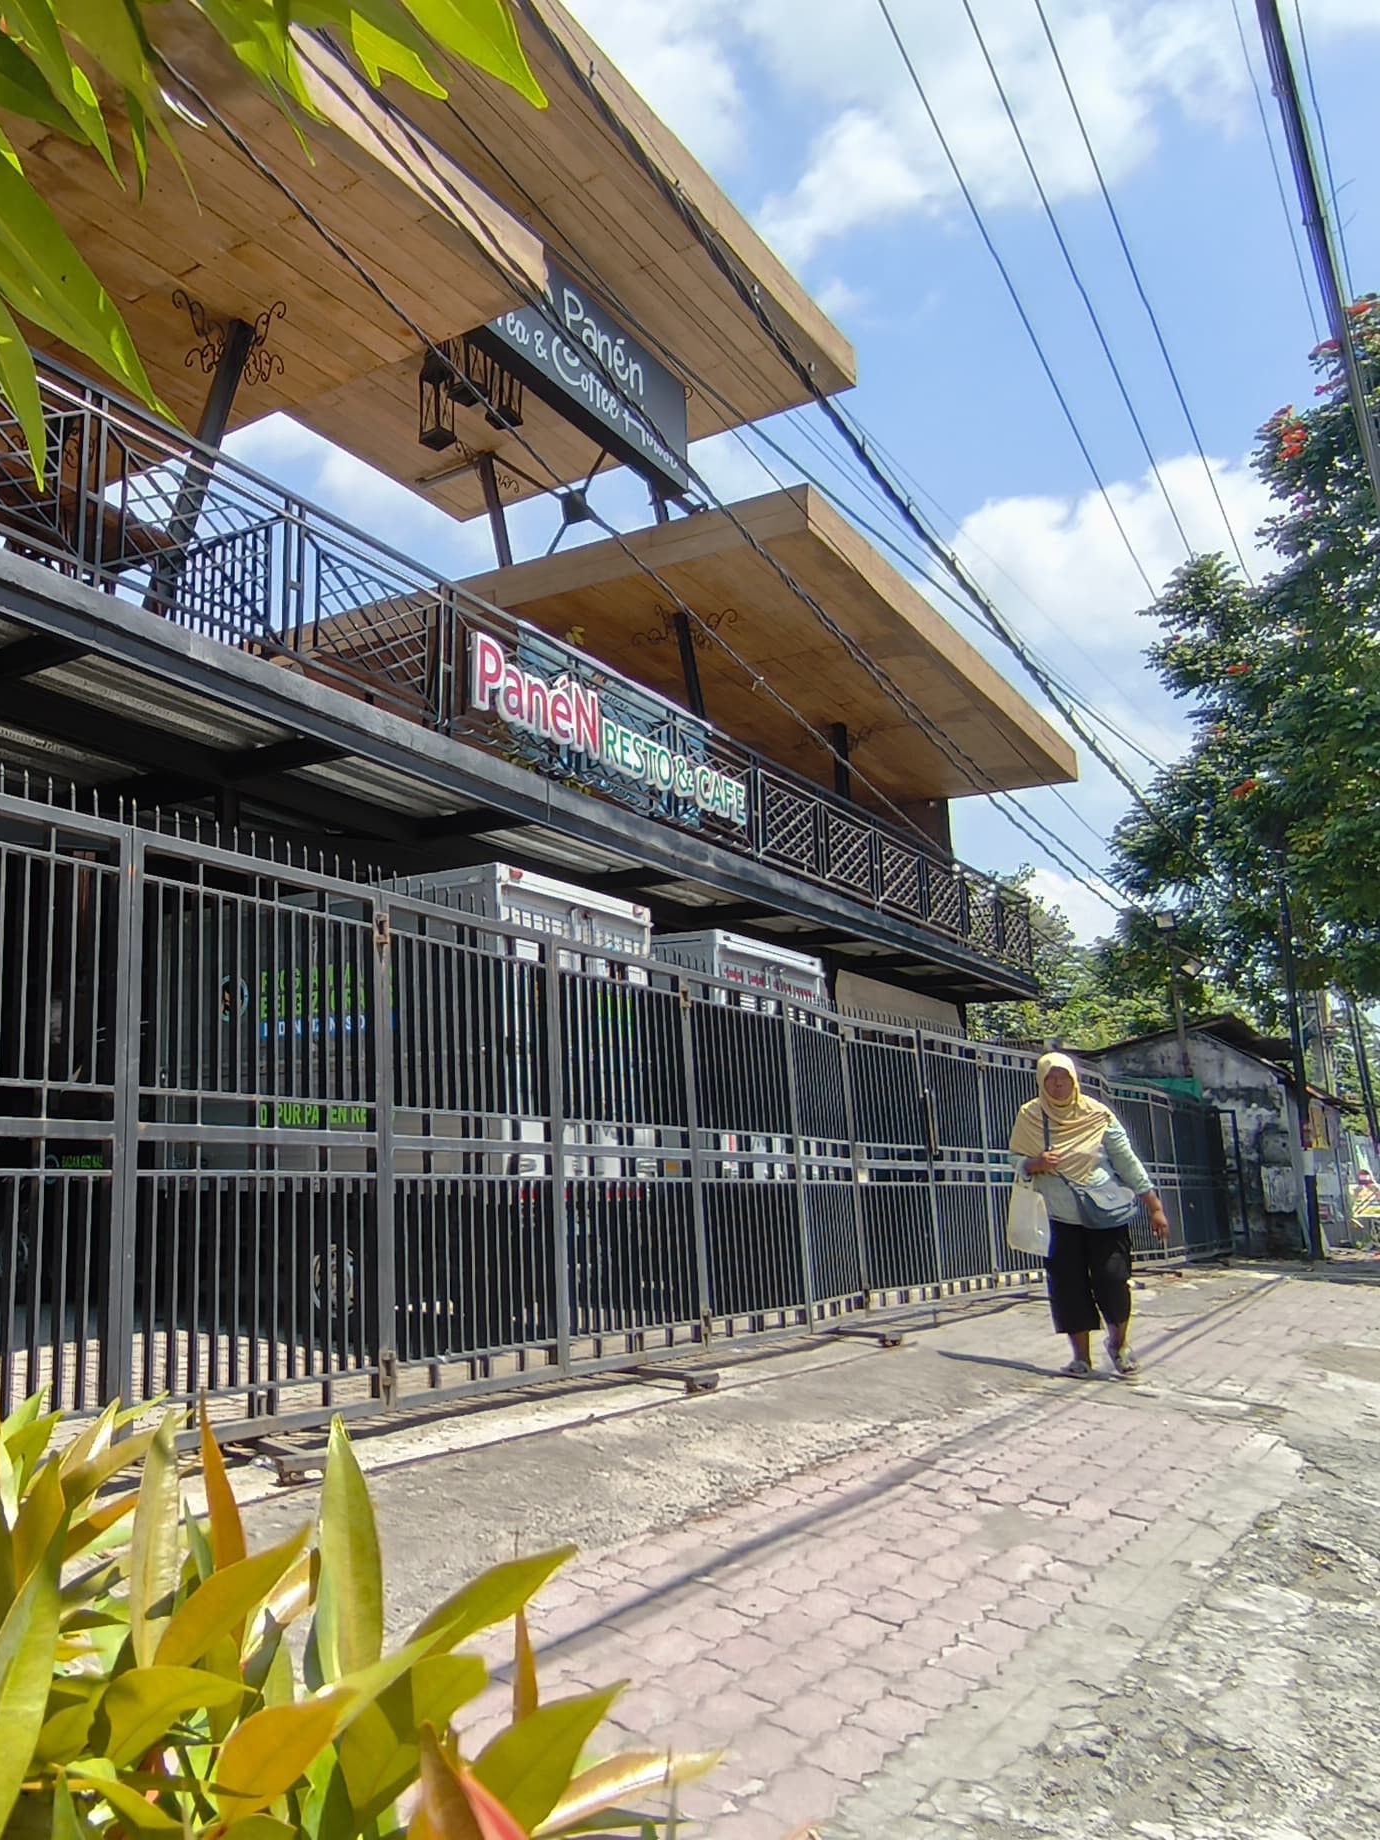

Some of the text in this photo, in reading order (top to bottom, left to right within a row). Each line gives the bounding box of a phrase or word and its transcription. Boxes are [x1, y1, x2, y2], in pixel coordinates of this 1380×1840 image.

[533, 330, 548, 361] &
[602, 717, 675, 792] RESTO
[674, 754, 695, 798] &
[694, 765, 747, 827] CAFE
